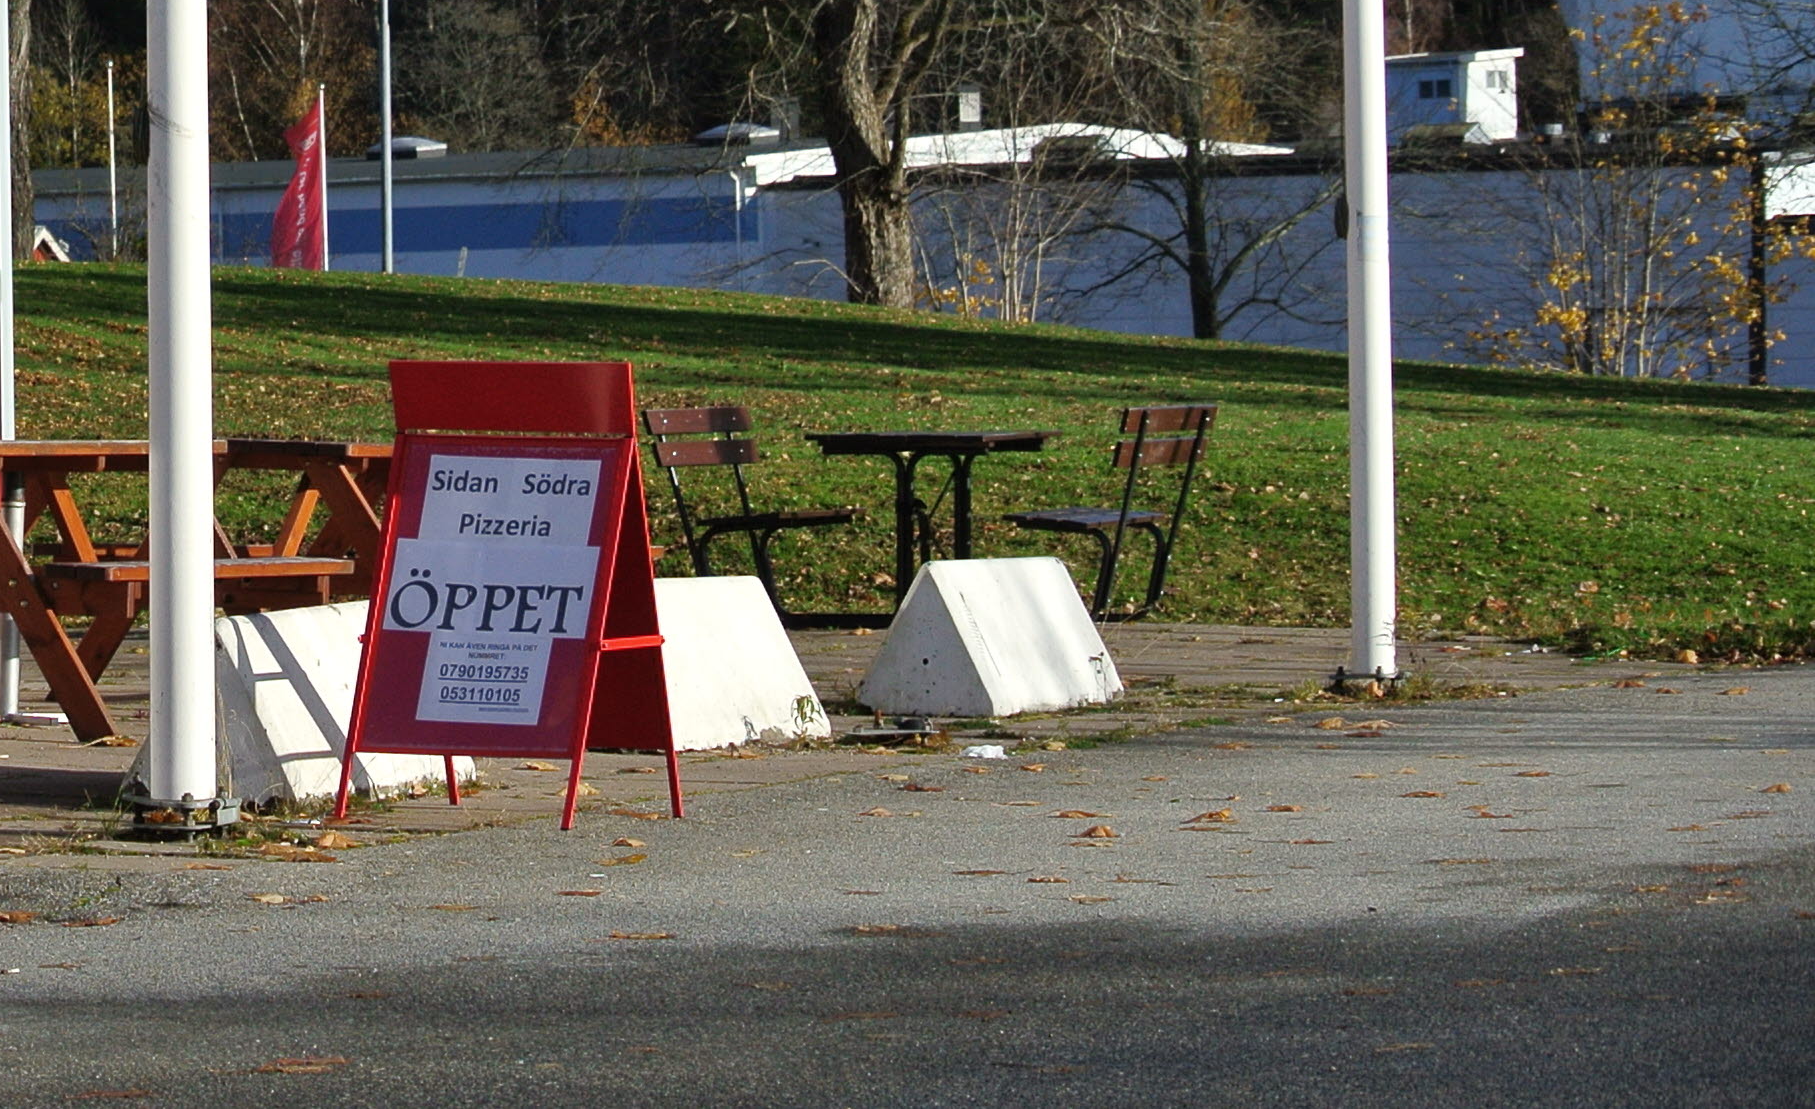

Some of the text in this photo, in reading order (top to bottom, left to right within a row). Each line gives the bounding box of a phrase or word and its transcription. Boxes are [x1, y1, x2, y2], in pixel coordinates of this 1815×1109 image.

[432, 470, 591, 496] Sidan Södra
[459, 513, 551, 537] Pizzeria
[391, 567, 584, 635] ÖPPET
[439, 663, 529, 680] 0790195735
[440, 686, 521, 702] 053110105
